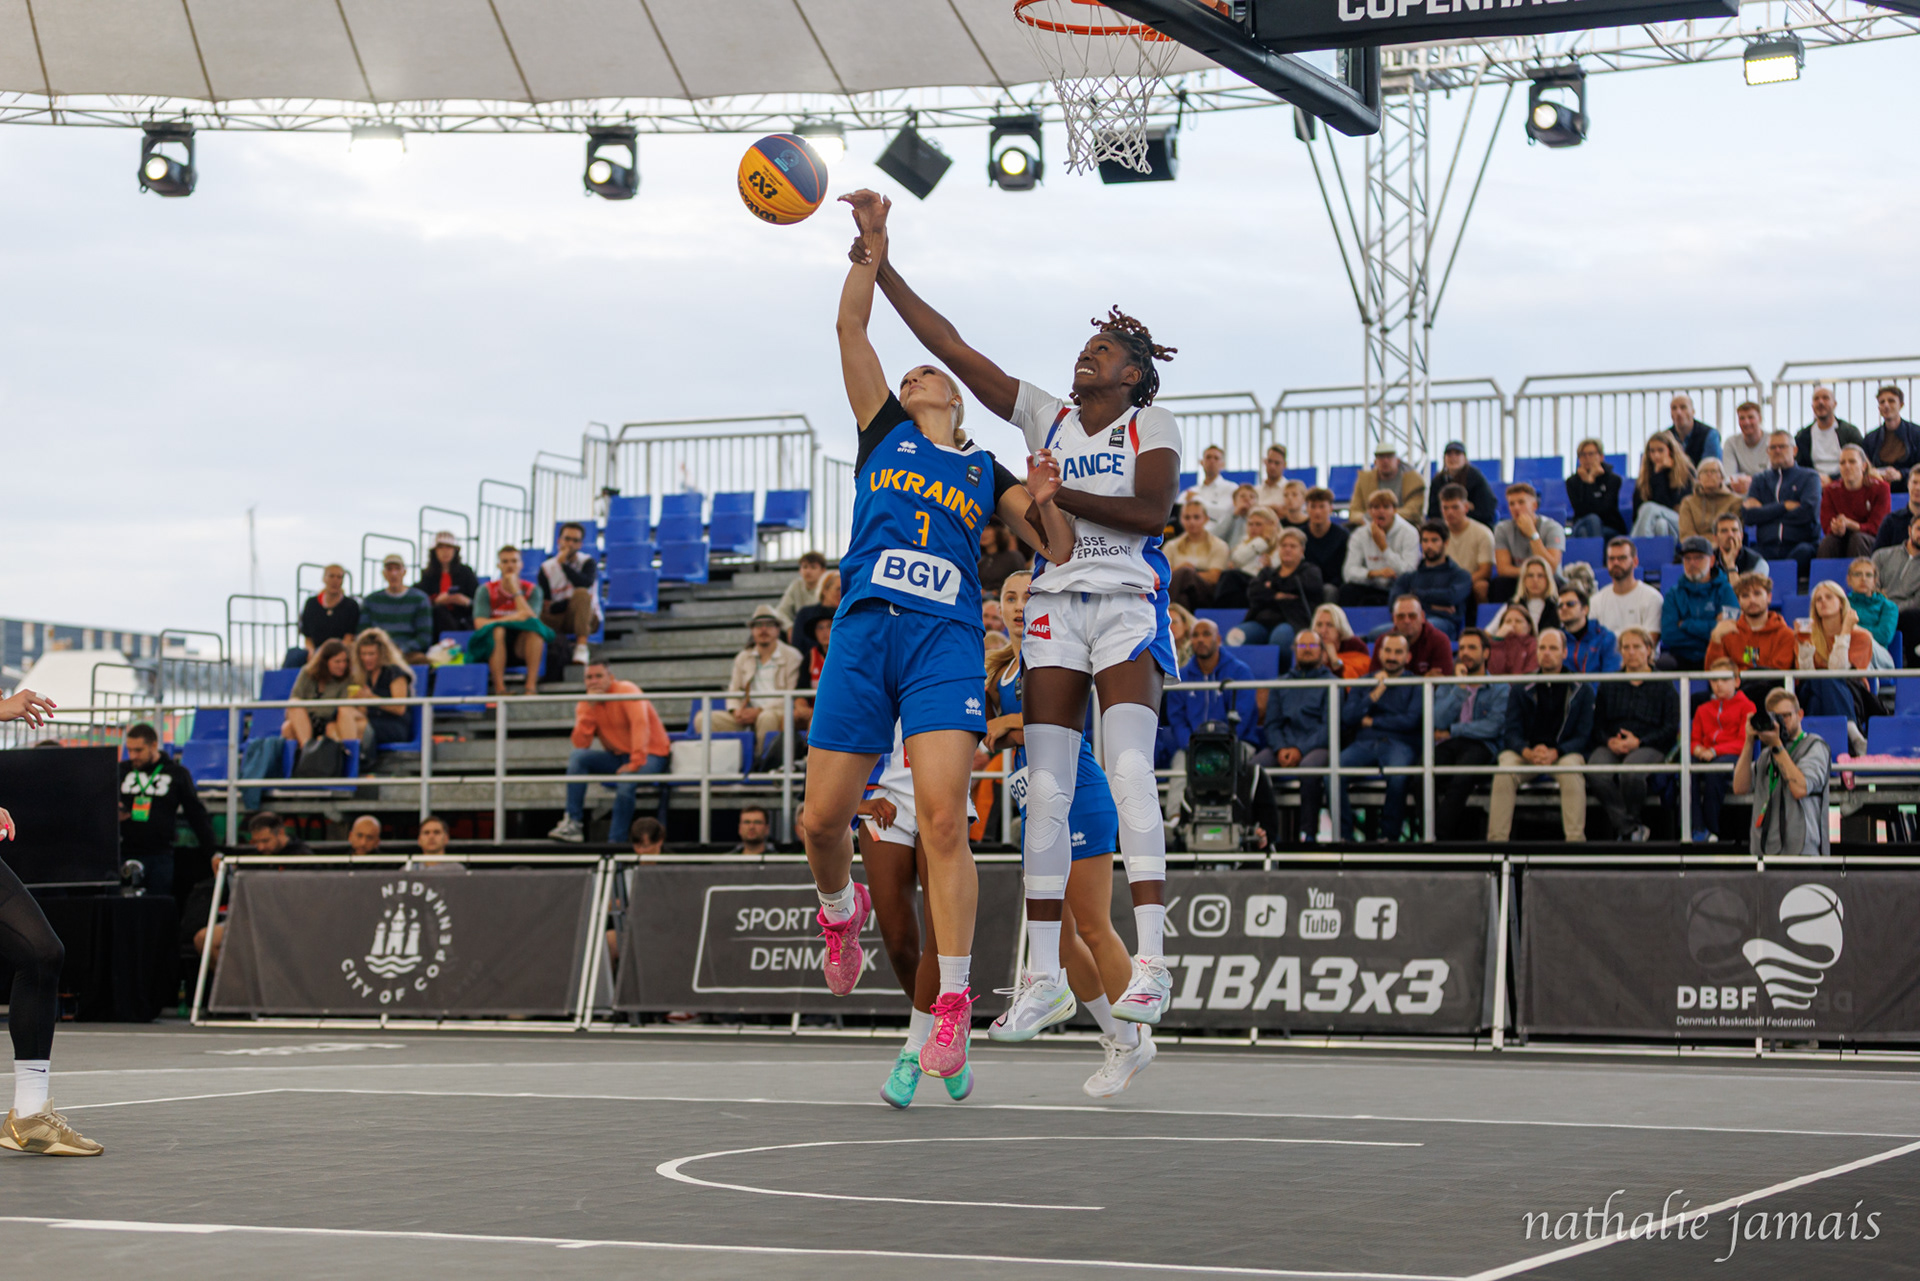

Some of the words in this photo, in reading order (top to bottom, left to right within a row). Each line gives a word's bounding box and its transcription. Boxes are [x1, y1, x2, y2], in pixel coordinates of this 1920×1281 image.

[1063, 453, 1125, 481] ANCE
[870, 468, 983, 530] UKRAINE
[883, 556, 952, 592] BGV
[1307, 887, 1334, 909] You
[735, 907, 817, 932] SPORT
[1304, 914, 1337, 934] Tube
[381, 880, 453, 992] COPENHAGEN
[750, 947, 878, 971] DENMK
[341, 958, 374, 998] CITY
[379, 988, 406, 1004] OF
[1677, 985, 1757, 1010] DBBF
[1676, 1016, 1718, 1026] Denmark
[1720, 1016, 1764, 1027] Basketball
[1767, 1017, 1816, 1027] Federation
